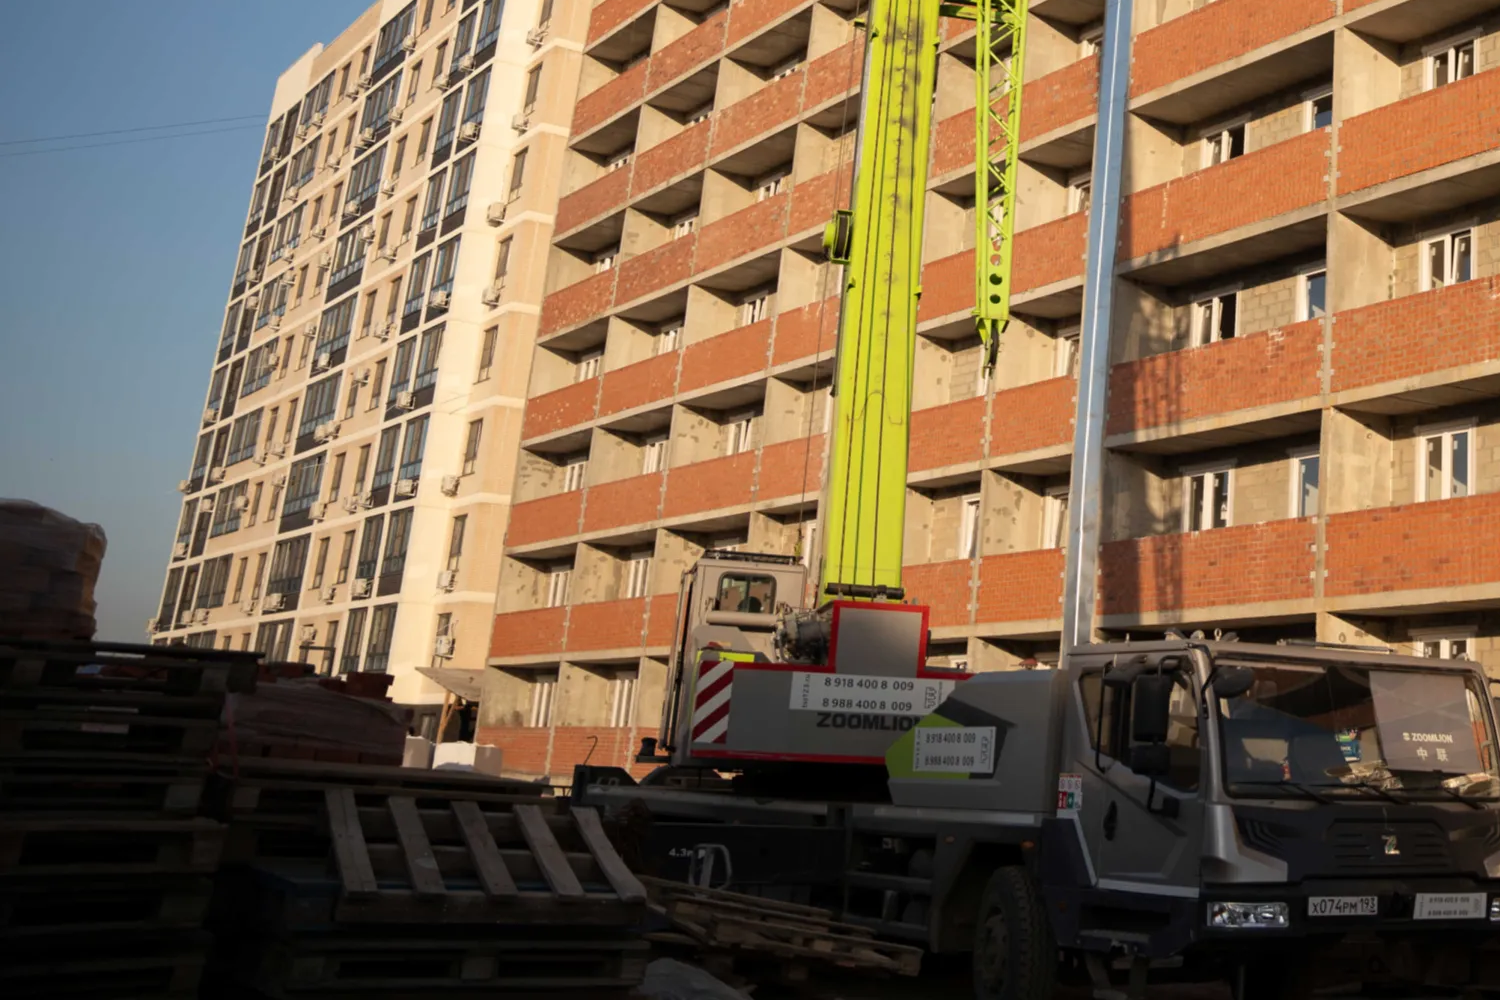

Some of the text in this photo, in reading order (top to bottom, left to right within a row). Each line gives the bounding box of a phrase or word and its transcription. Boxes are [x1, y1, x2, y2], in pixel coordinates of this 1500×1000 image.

[825, 677, 914, 691] 8 918 400 8 009
[822, 698, 912, 711] 8 988 400 8 009
[1411, 732, 1454, 743] ZOOMLION
[1360, 898, 1376, 912] 193
